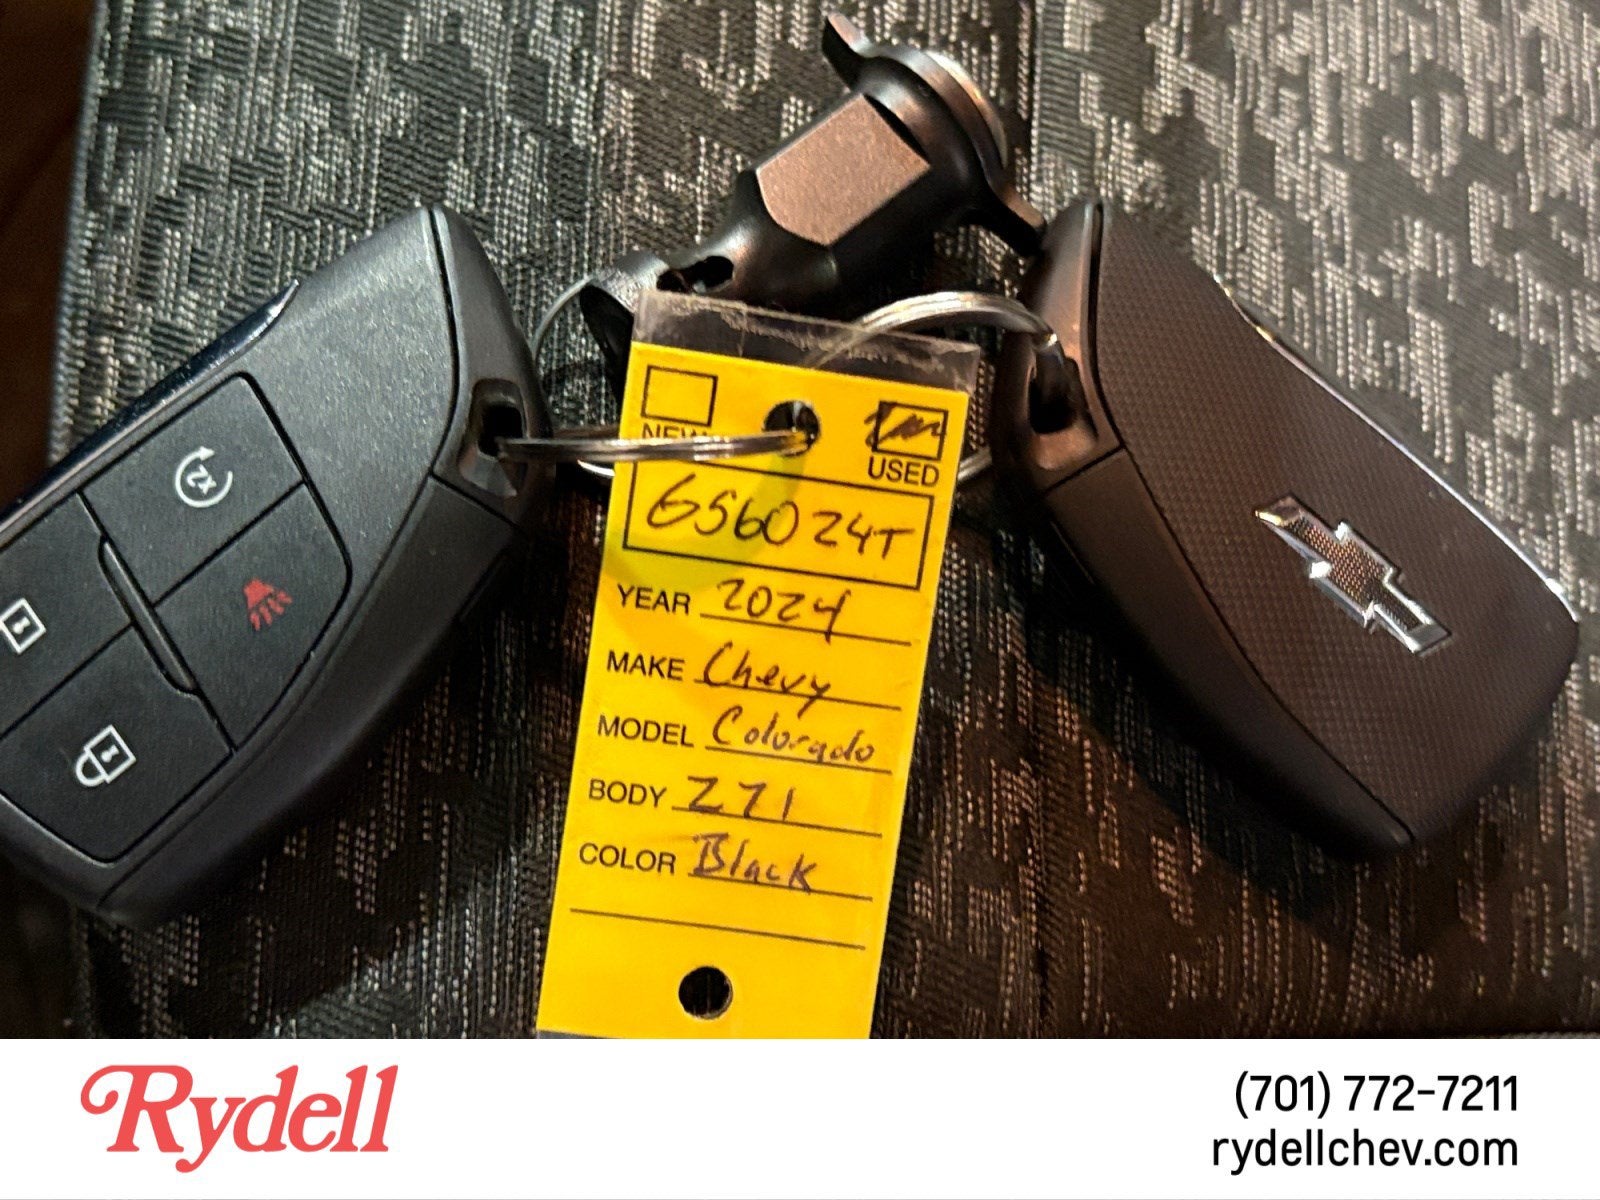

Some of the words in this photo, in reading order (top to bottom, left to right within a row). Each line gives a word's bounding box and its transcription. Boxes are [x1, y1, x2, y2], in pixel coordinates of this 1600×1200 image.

[867, 456, 940, 487] USED
[617, 584, 692, 616] YEAR
[717, 579, 852, 645] 2024
[606, 650, 685, 682] MAKE
[702, 641, 832, 719] Chevy
[597, 714, 694, 749] MODEL
[588, 778, 667, 810] BODY
[687, 776, 796, 822] Z71
[579, 843, 676, 876] COLOR
[692, 832, 818, 894] Black
